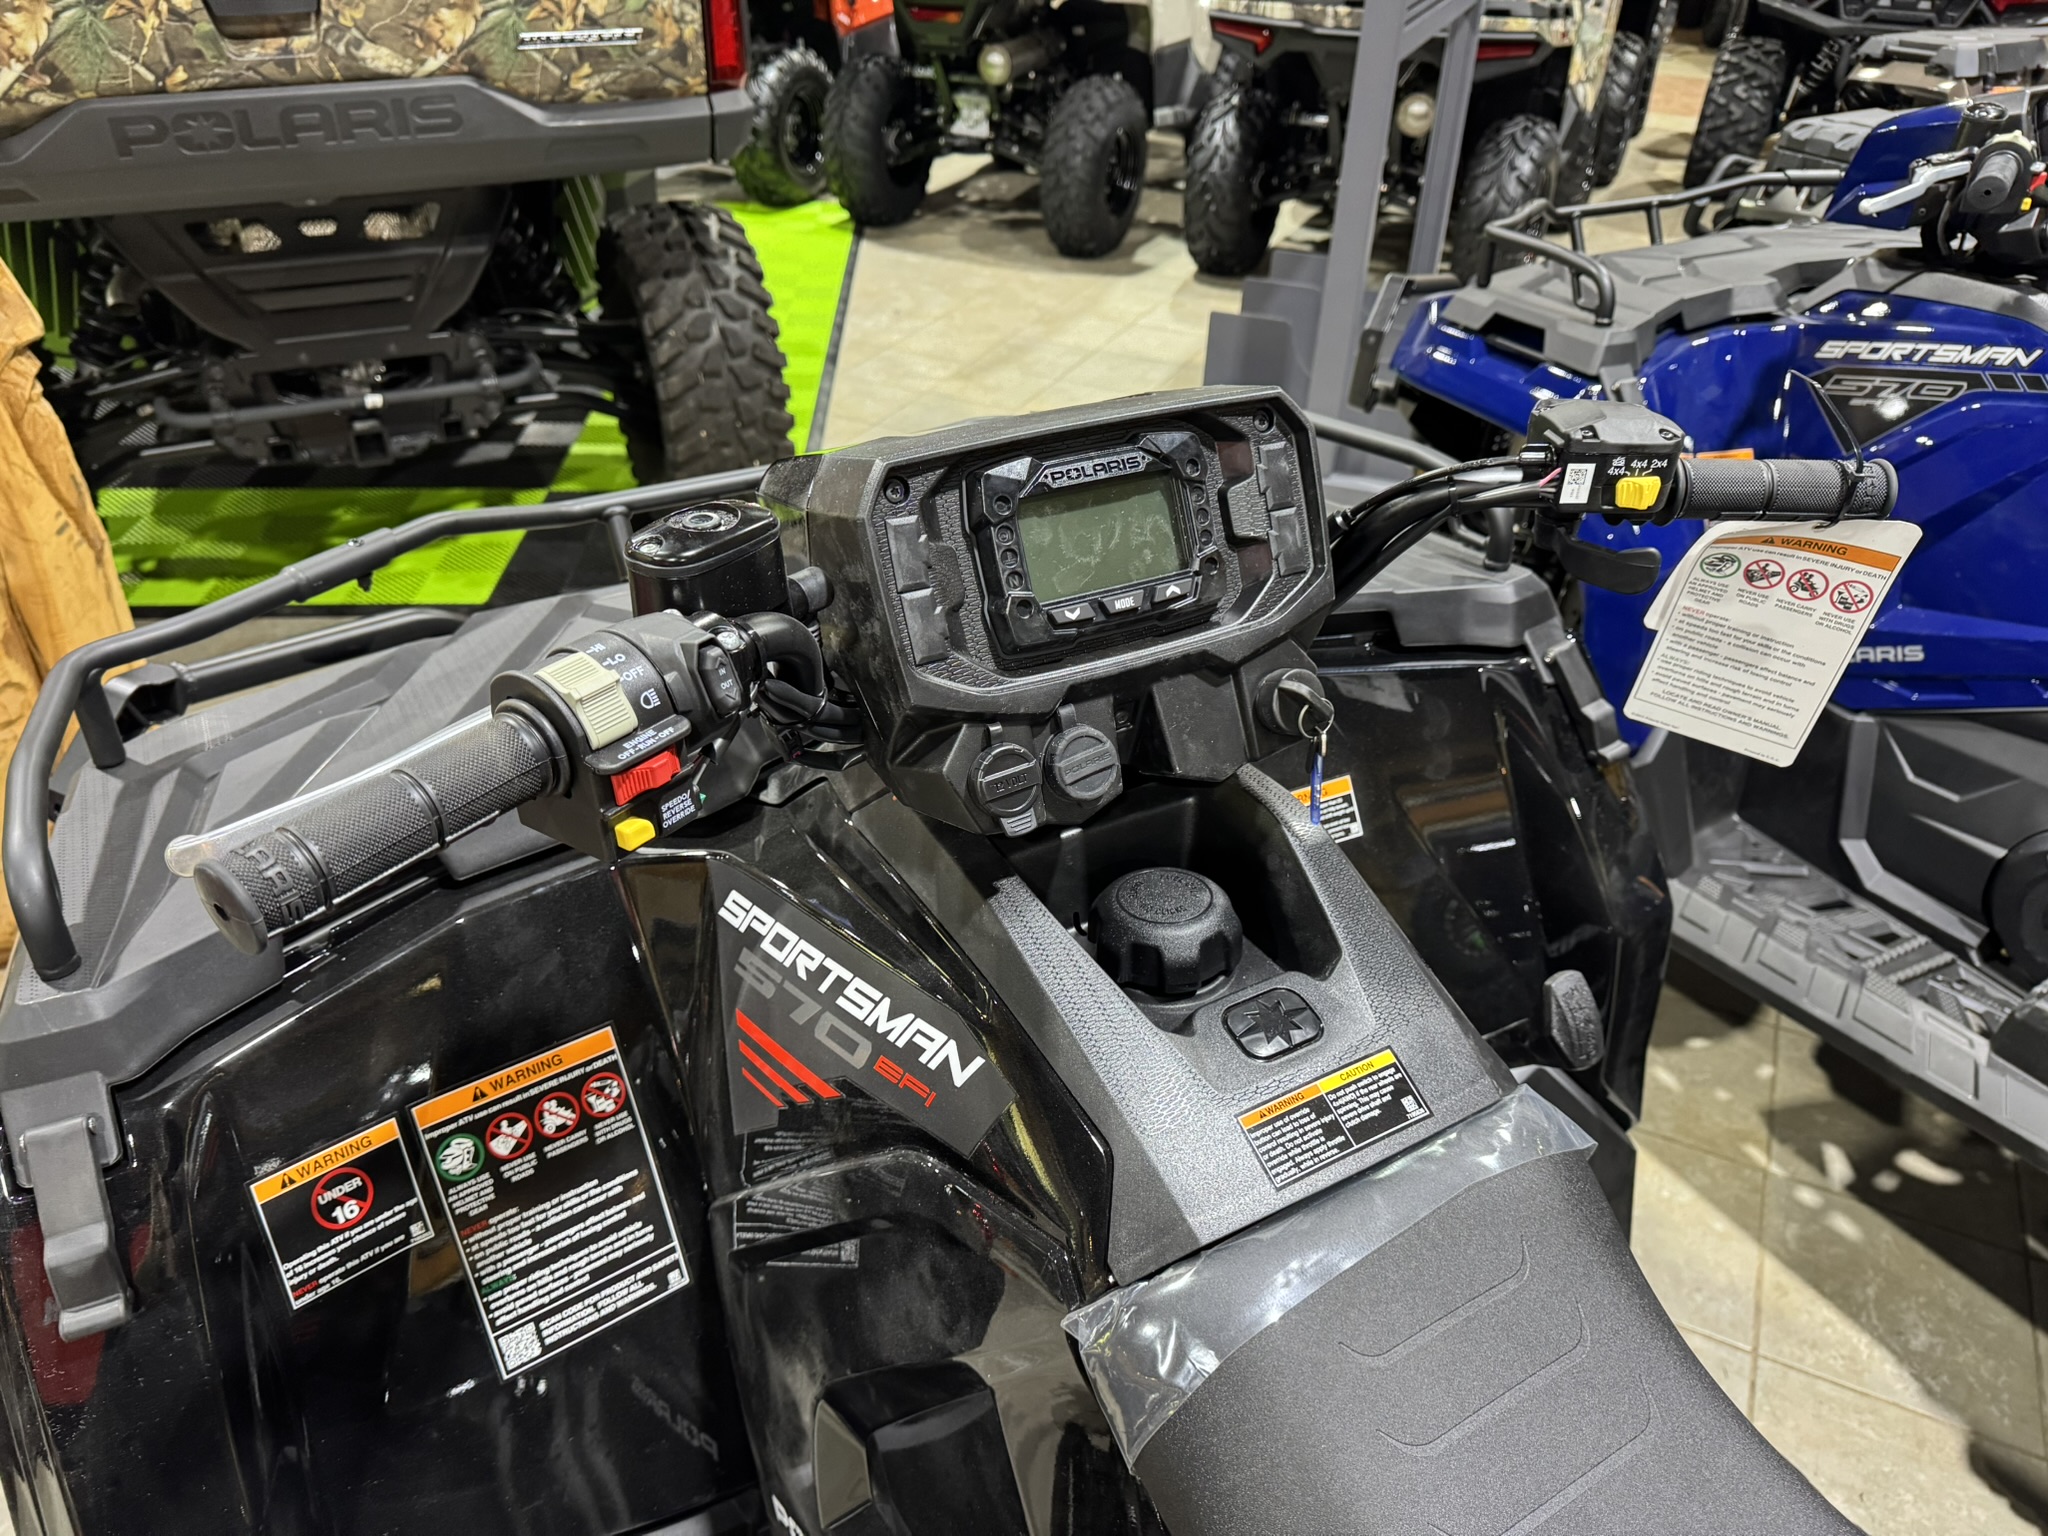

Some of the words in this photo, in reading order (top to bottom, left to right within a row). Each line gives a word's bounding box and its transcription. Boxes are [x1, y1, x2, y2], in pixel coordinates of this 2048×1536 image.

[107, 94, 463, 160] POLARIS
[1814, 340, 2044, 368] SPORTSMAN
[1822, 374, 1967, 401] 570
[1050, 455, 1142, 484] POLARIS
[1607, 467, 1625, 476] 4x4
[1630, 459, 1648, 469] 4x4
[1651, 459, 1668, 468] 2x4
[1781, 537, 1848, 556] WARNING
[1802, 556, 1830, 566] SEVERE
[1830, 562, 1855, 573] INJURY
[1862, 570, 1887, 581] DEATH
[1114, 596, 1136, 610] MODE
[1775, 603, 1813, 618] PASSENGERS
[1776, 598, 1796, 607] NEVER
[1796, 603, 1816, 613] CARRY
[1818, 616, 1834, 625] WITH
[1834, 620, 1854, 630] DRUGS
[1823, 611, 1841, 620] NEVER
[1842, 616, 1856, 624] USE
[1825, 623, 1852, 635] ALCOHOL
[591, 643, 606, 653] HI
[1850, 644, 1925, 664] ARIS
[607, 653, 626, 666] LO
[622, 665, 645, 681] OFF
[718, 667, 727, 677] IN
[720, 678, 734, 690] OUT
[623, 729, 658, 749] ENGINE
[1065, 751, 1112, 777] POLARIS
[1006, 773, 1028, 788] VOLT
[661, 789, 691, 812] SPEEDO/
[663, 798, 693, 820] REVERSE
[662, 805, 696, 829] OVERRIDE
[717, 889, 986, 1088] SPORTSMAN
[734, 947, 872, 1070] 570
[490, 1054, 562, 1090] WARNING
[1339, 1061, 1374, 1080] CAUTION
[873, 1055, 937, 1109] EFI
[424, 1122, 457, 1140] Improper
[458, 1114, 473, 1126] ATV
[528, 1078, 559, 1096] SEVERE
[558, 1067, 584, 1083] INJURY
[592, 1053, 617, 1068] DEATH
[1265, 1092, 1304, 1114] WARNING
[296, 1136, 371, 1177] WARNING
[317, 1176, 363, 1205] UNDER
[331, 1199, 360, 1224] 16
[330, 1233, 344, 1245] ATV
[360, 1249, 373, 1261] ATV
